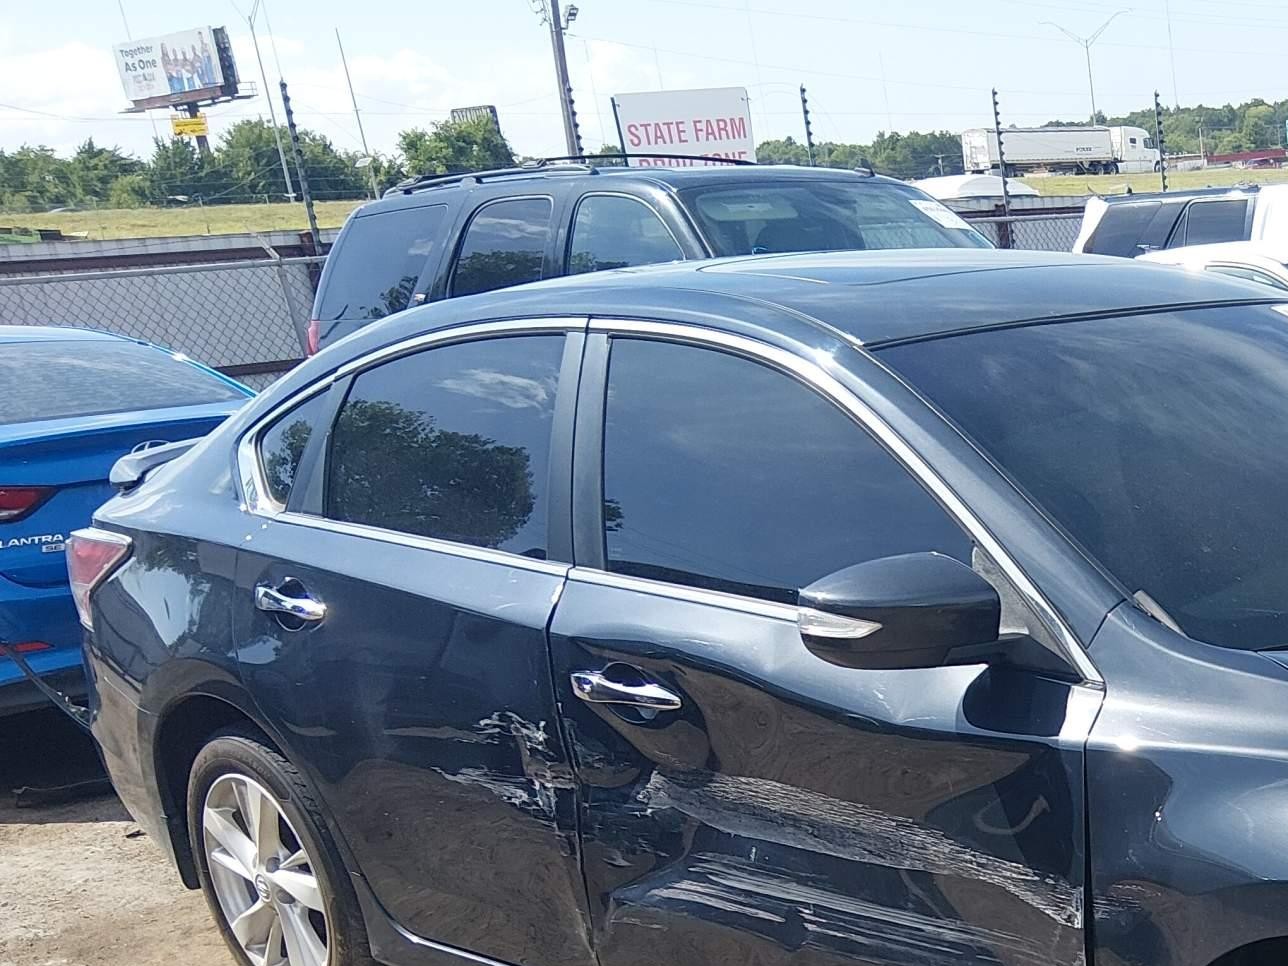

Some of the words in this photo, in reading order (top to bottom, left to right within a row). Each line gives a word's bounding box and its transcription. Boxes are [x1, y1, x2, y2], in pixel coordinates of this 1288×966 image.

[119, 46, 153, 58] Together
[125, 61, 138, 72] As
[138, 59, 157, 70] One
[627, 121, 688, 147] STATE
[693, 117, 747, 142] FARM
